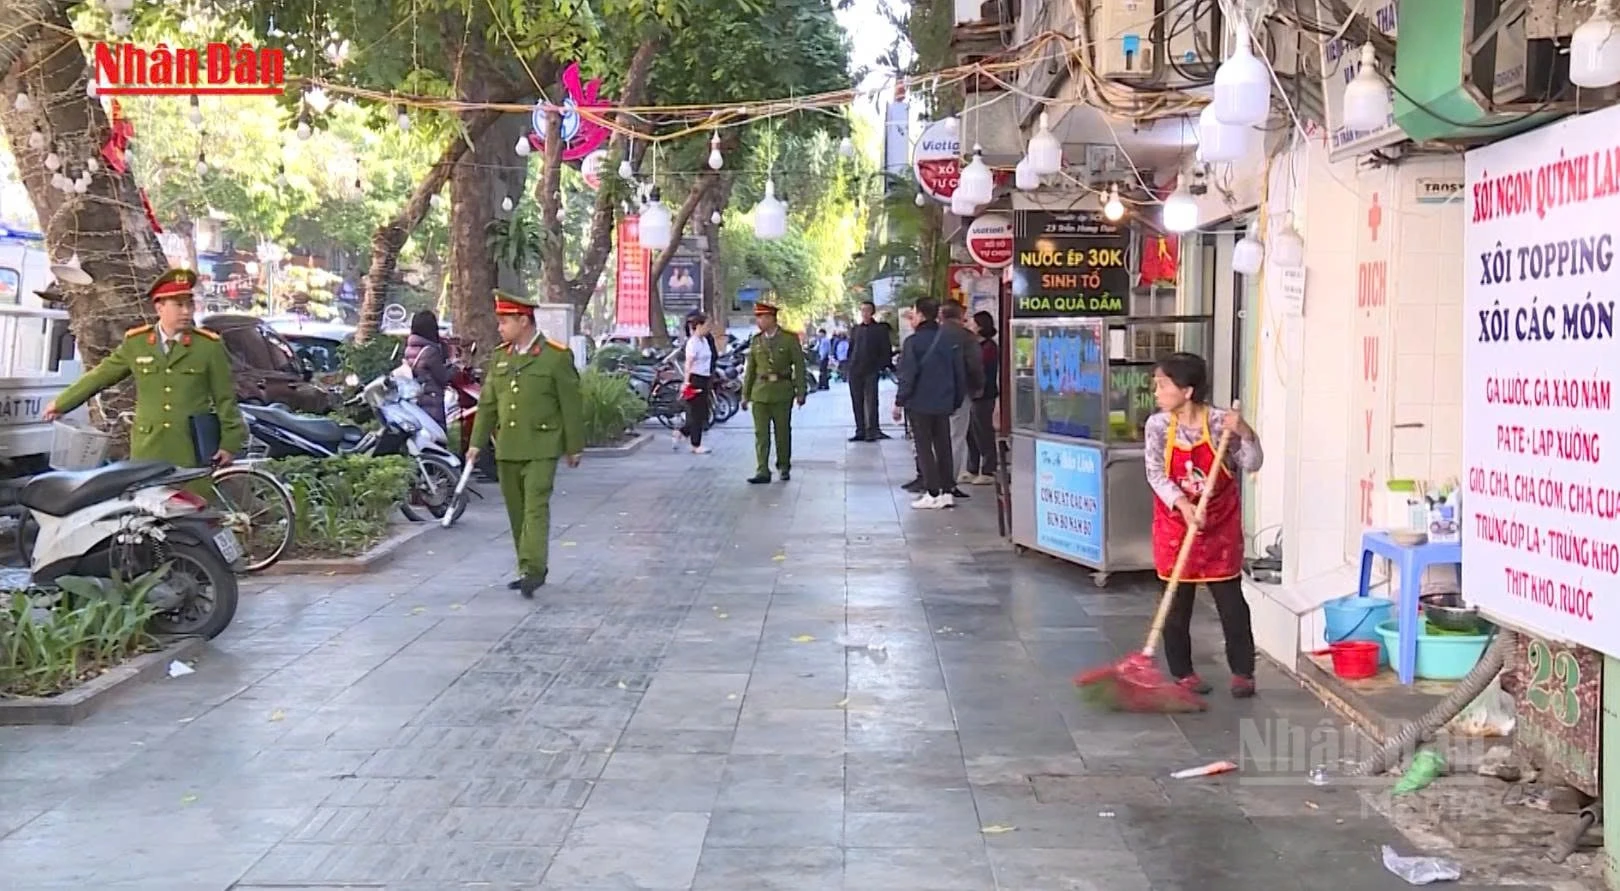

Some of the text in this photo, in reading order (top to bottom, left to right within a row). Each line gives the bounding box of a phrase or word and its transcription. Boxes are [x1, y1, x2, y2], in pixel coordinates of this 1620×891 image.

[922, 140, 960, 151] Vietlo
[1473, 169, 1493, 223] XÔI
[1496, 169, 1533, 218] NGON
[1088, 248, 1123, 267] 30K
[1480, 234, 1613, 285] XÔI TOPPING
[1042, 274, 1077, 288] SINH
[1019, 297, 1051, 310] HOA
[1478, 291, 1615, 342] XÔI CÁC MÓN
[1498, 424, 1525, 453] PATE
[1527, 525, 1540, 554] LA
[1591, 540, 1619, 574] KHO
[1526, 638, 1581, 728] 23
